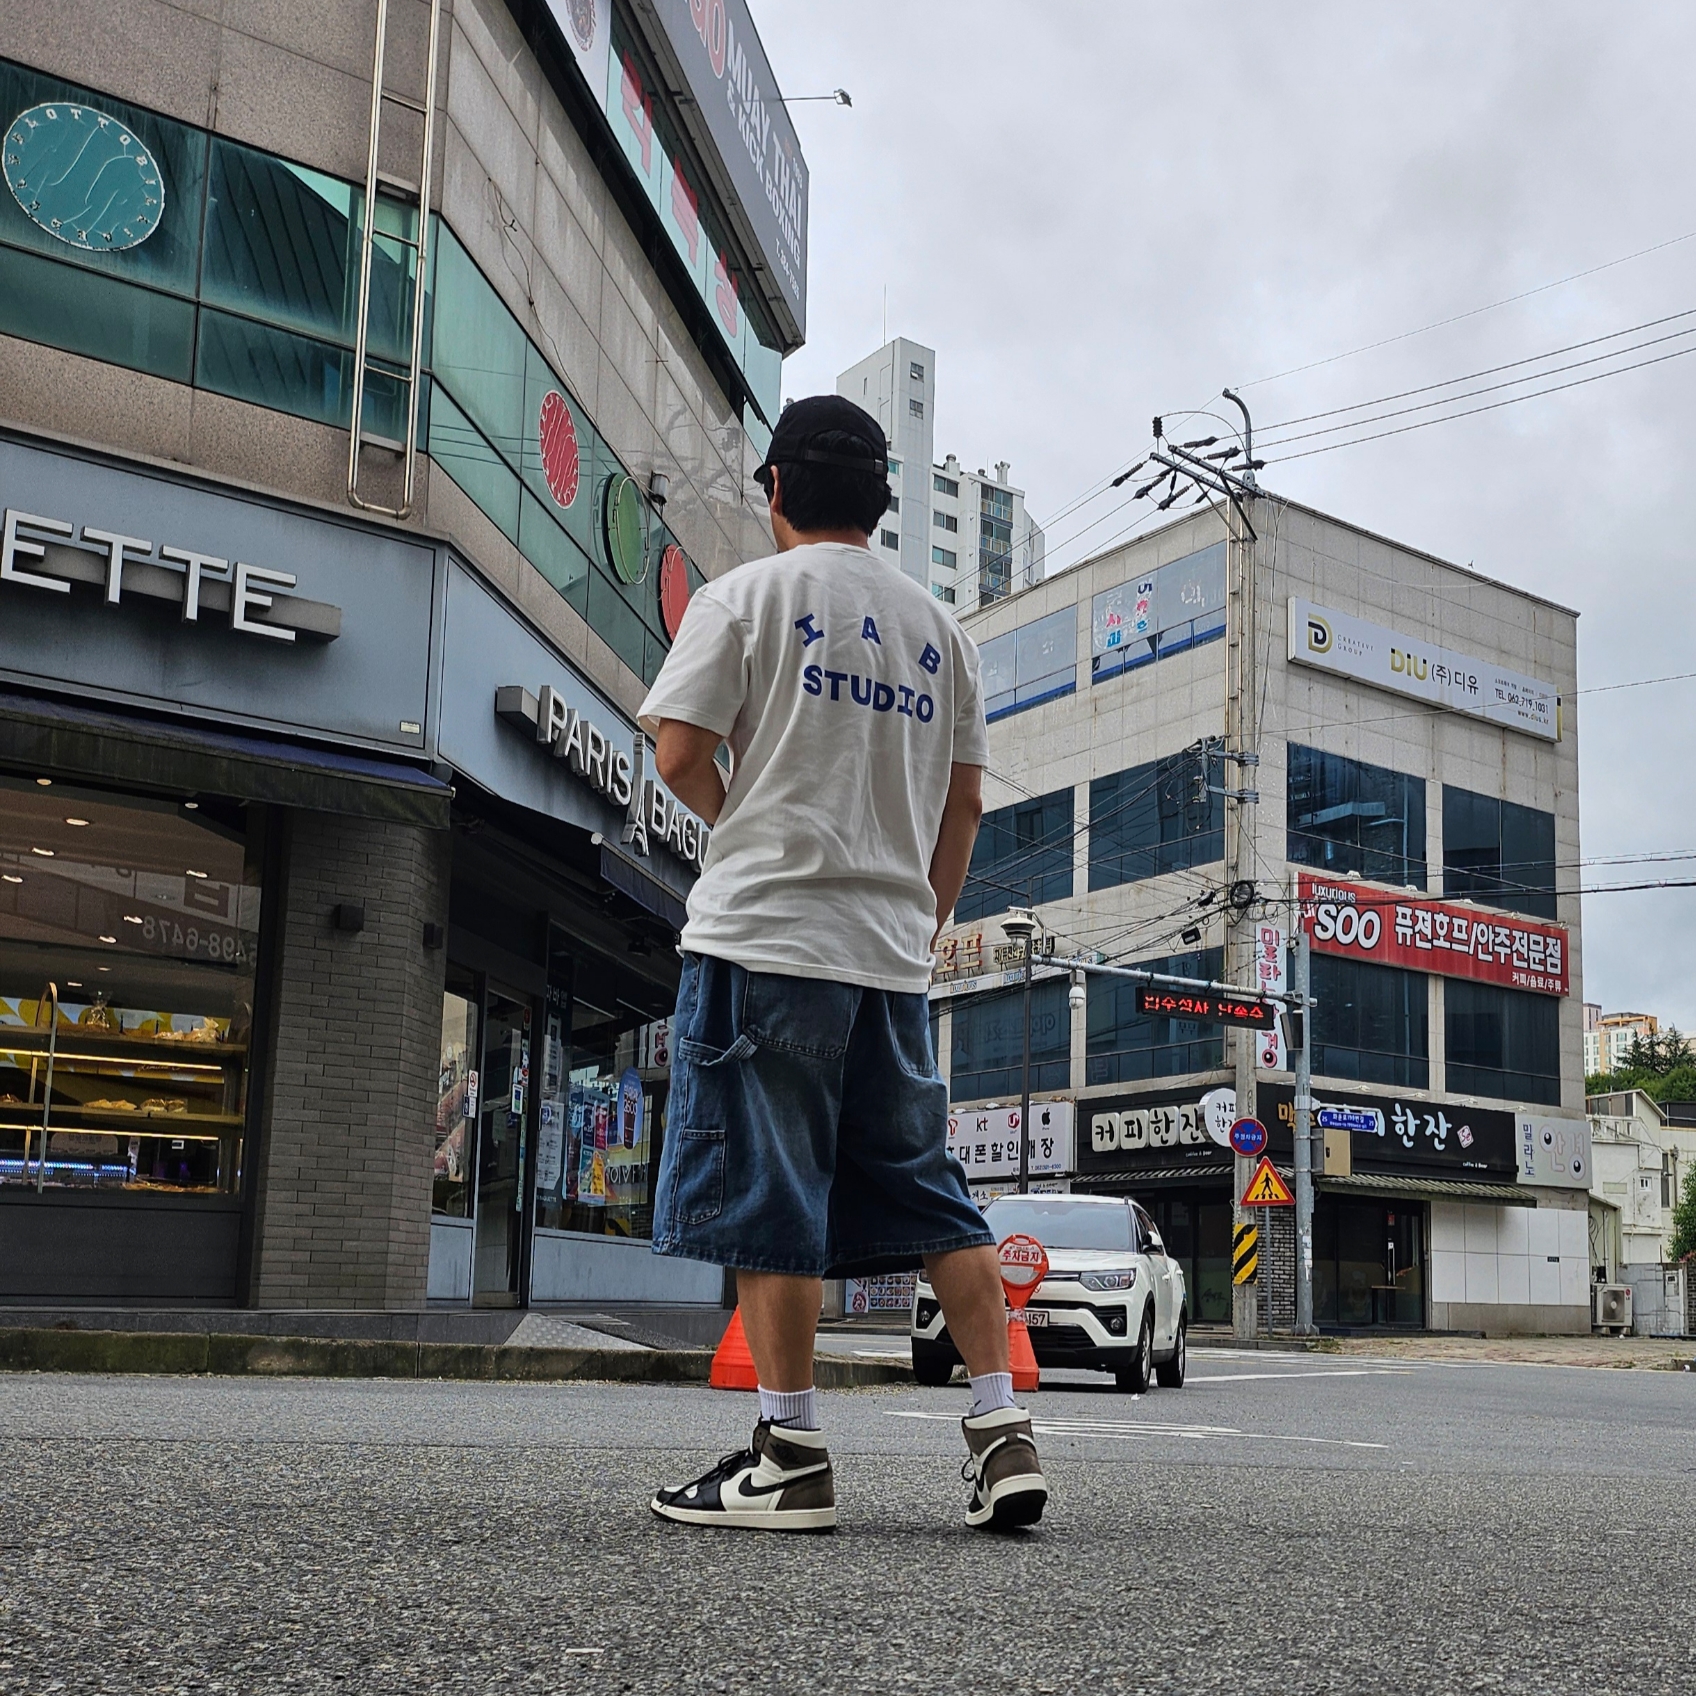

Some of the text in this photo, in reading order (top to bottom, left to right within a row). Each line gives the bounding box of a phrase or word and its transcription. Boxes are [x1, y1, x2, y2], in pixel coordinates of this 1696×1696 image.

[727, 18, 802, 239] MUAY THAI
[727, 79, 800, 270] & KICK BOXING
[1, 508, 298, 645] ETTE
[1337, 634, 1374, 652] CREATIVE
[1337, 643, 1363, 656] GROUP
[803, 664, 934, 723] STUDIO
[537, 685, 632, 806] PARIS
[1311, 882, 1356, 903] luxurious
[1313, 904, 1382, 950] SOO
[976, 1117, 989, 1132] kt
[1390, 1102, 1453, 1151] 한잔
[1538, 1124, 1587, 1181] 안경
[1003, 1249, 1040, 1262] 주차금지
